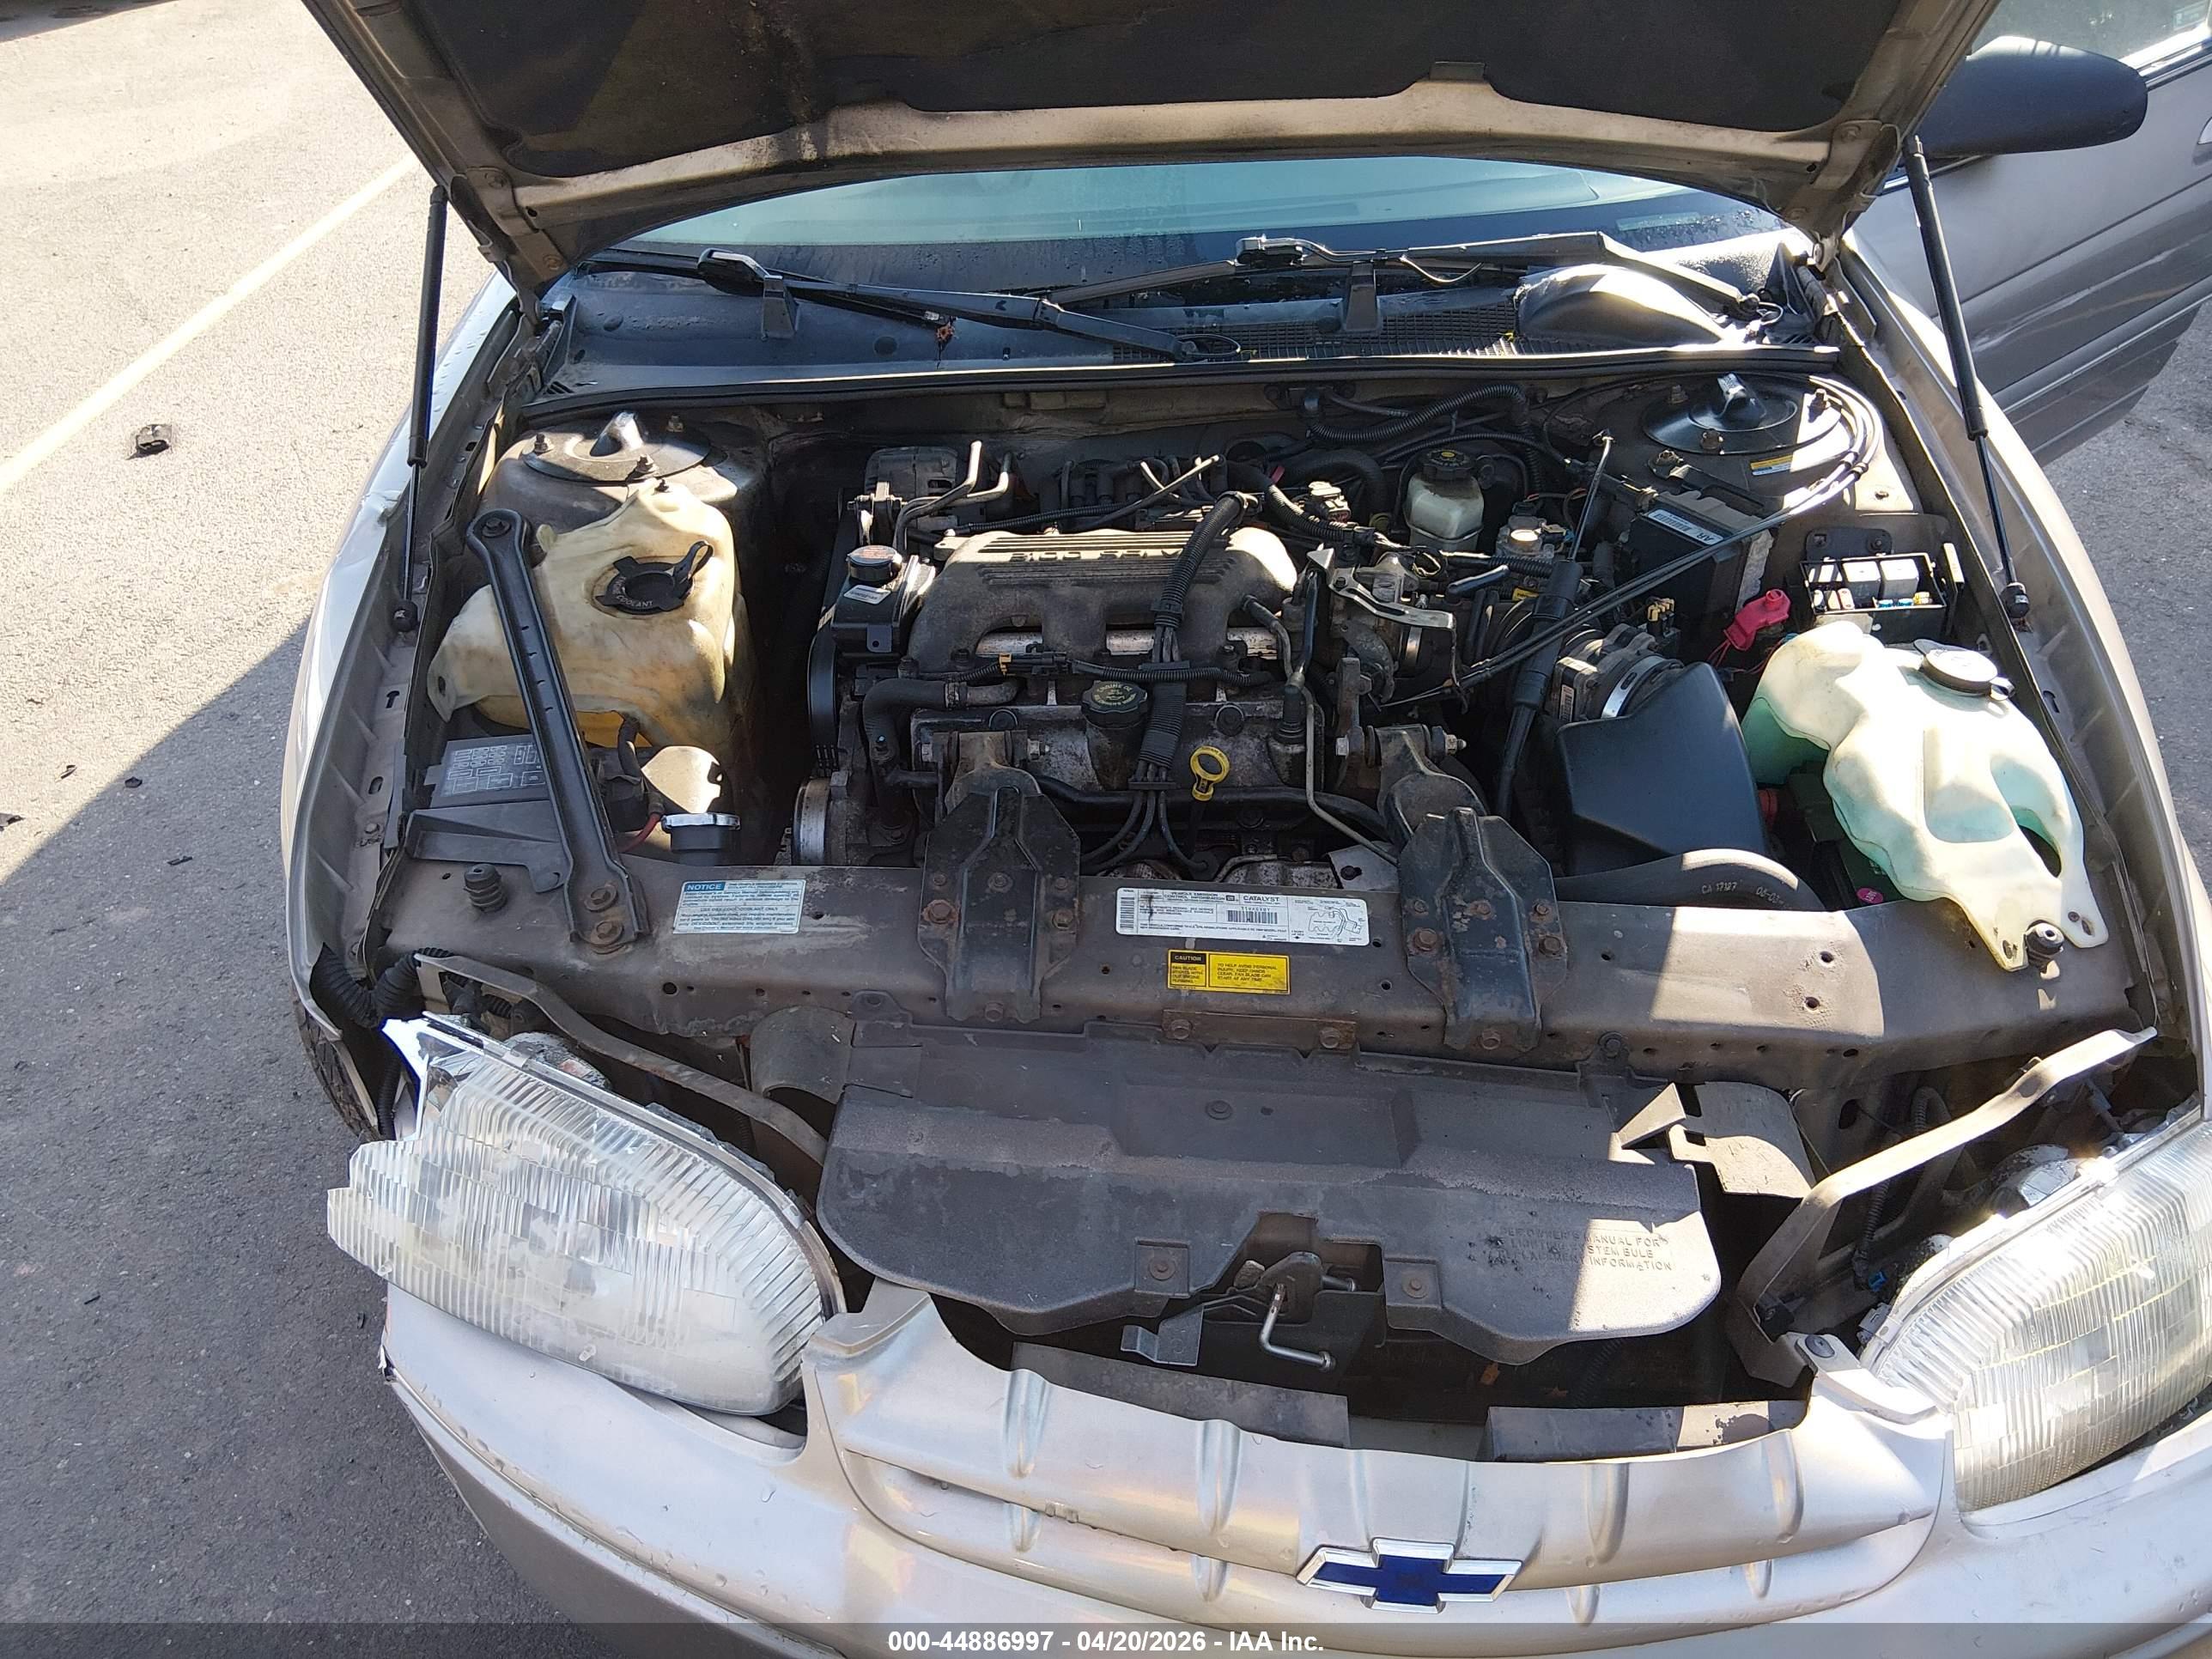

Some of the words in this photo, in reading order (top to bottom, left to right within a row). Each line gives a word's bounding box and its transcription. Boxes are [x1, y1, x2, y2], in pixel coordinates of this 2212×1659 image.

[616, 594, 653, 608] COOLANT
[1585, 1234, 1632, 1246] MANUAL
[1636, 1237, 1661, 1247] FOR
[1589, 1256, 1673, 1271] INFORMATION
